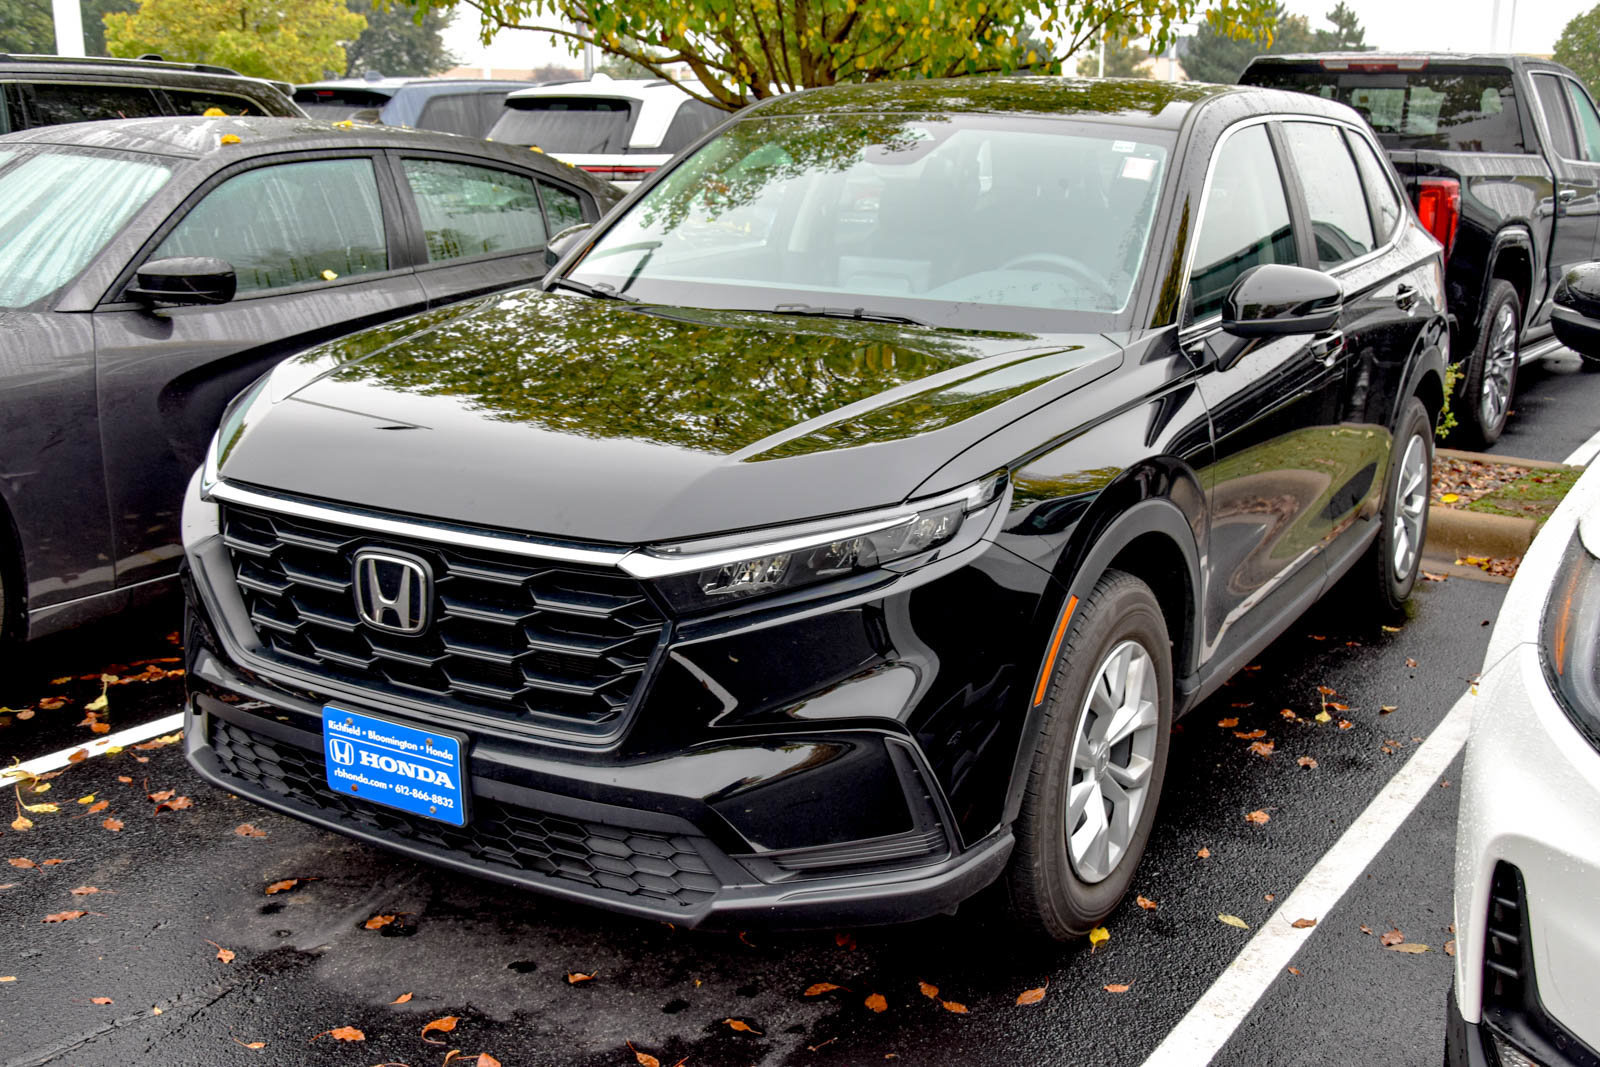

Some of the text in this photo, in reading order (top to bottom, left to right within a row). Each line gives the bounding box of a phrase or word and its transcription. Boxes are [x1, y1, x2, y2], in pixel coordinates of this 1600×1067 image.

[328, 720, 454, 761] Richfield Bloomington Honda
[334, 768, 454, 808] rbhonda.com 612-866-8832
[358, 750, 456, 789] HONDA
